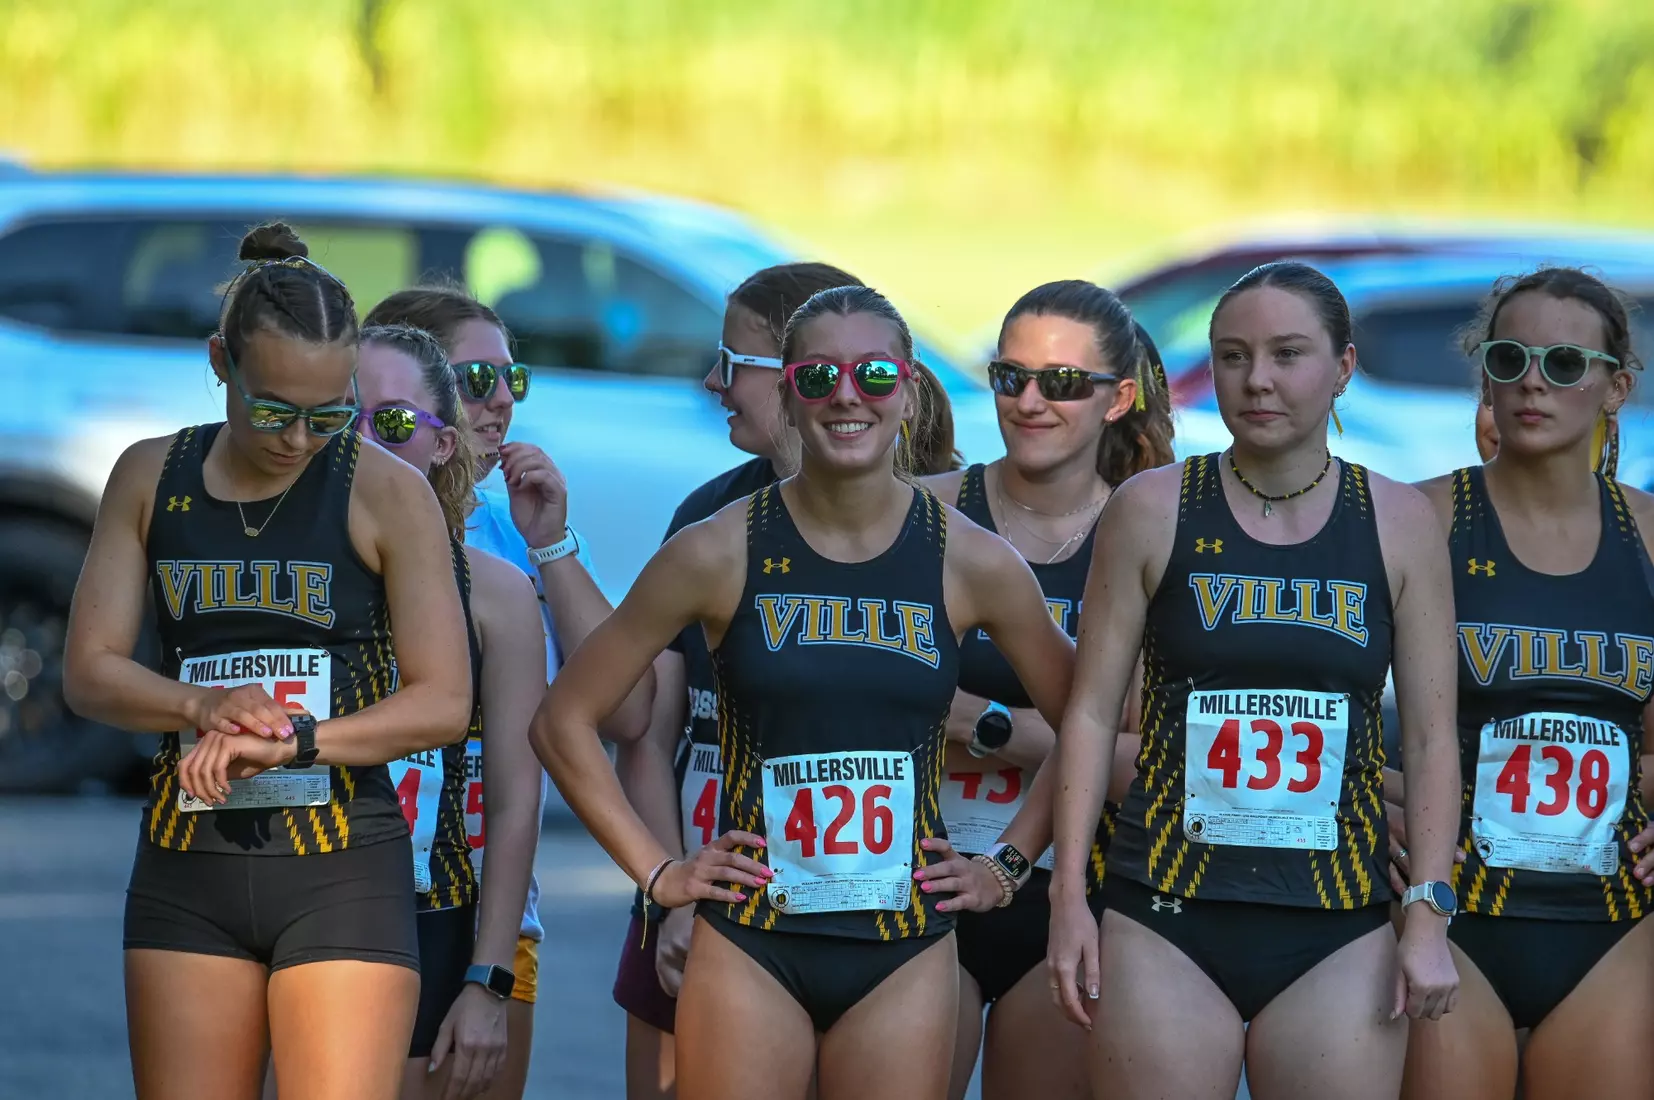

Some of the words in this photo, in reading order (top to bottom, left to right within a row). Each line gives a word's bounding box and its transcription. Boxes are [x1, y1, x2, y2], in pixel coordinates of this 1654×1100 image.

[156, 560, 336, 629] VILLE
[755, 593, 940, 669] VILLE
[1188, 573, 1370, 648] VILLE
[189, 654, 319, 684] MILLERSVILLE
[1457, 622, 1654, 701] VILLE
[1199, 693, 1337, 721] MILLERSVILLE
[1493, 717, 1621, 747] MILLERSVILLE
[773, 757, 905, 787] MILLERSVILLE
[1207, 718, 1325, 793] 433
[1495, 744, 1610, 820] 438
[783, 784, 894, 858] 426
